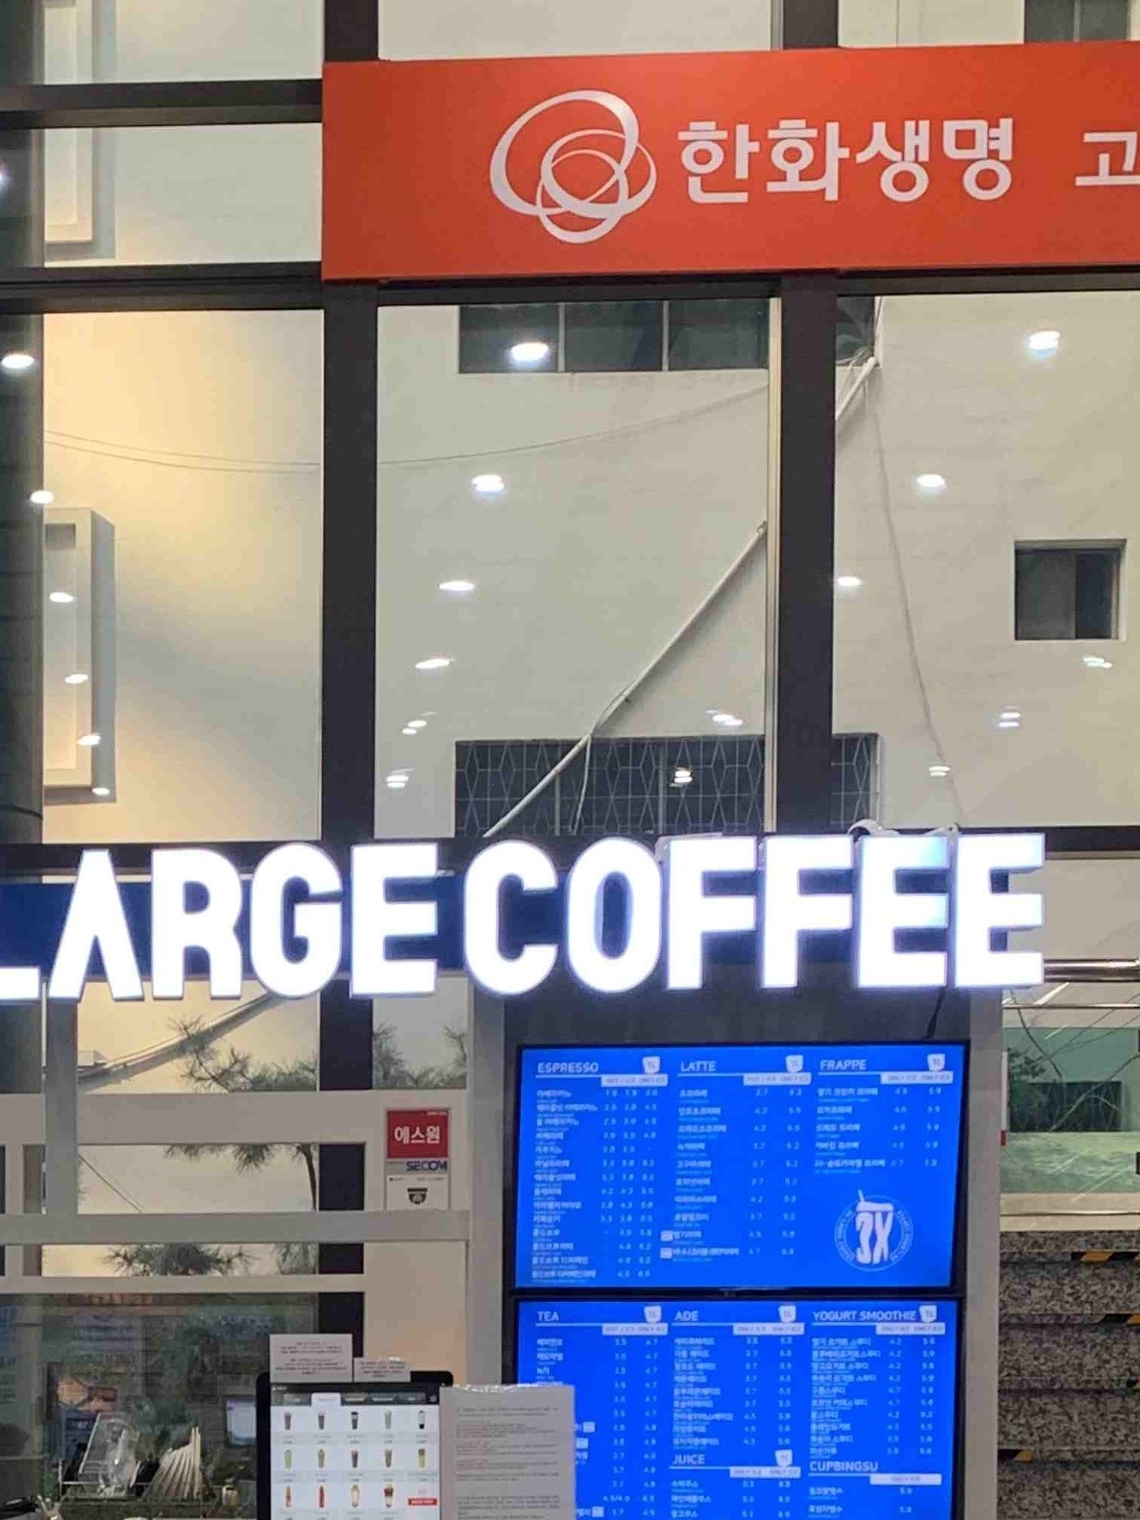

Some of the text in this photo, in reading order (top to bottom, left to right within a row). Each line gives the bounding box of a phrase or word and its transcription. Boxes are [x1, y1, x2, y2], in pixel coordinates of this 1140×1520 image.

[678, 117, 1014, 204] 한화생명
[463, 832, 1045, 997] COFFEE
[537, 1062, 599, 1073] ESPRESSO
[680, 1060, 717, 1072] LATTE
[820, 1059, 867, 1071] FRAPPE
[394, 1126, 441, 1144] 에스원
[406, 1161, 447, 1171] SECOM
[537, 1311, 559, 1321] TEA
[675, 1311, 699, 1322] ADE
[812, 1310, 917, 1321] YOGURT SMOOTHIE
[672, 1454, 705, 1465] JUICE
[809, 1461, 879, 1472] CUPBINGSU
